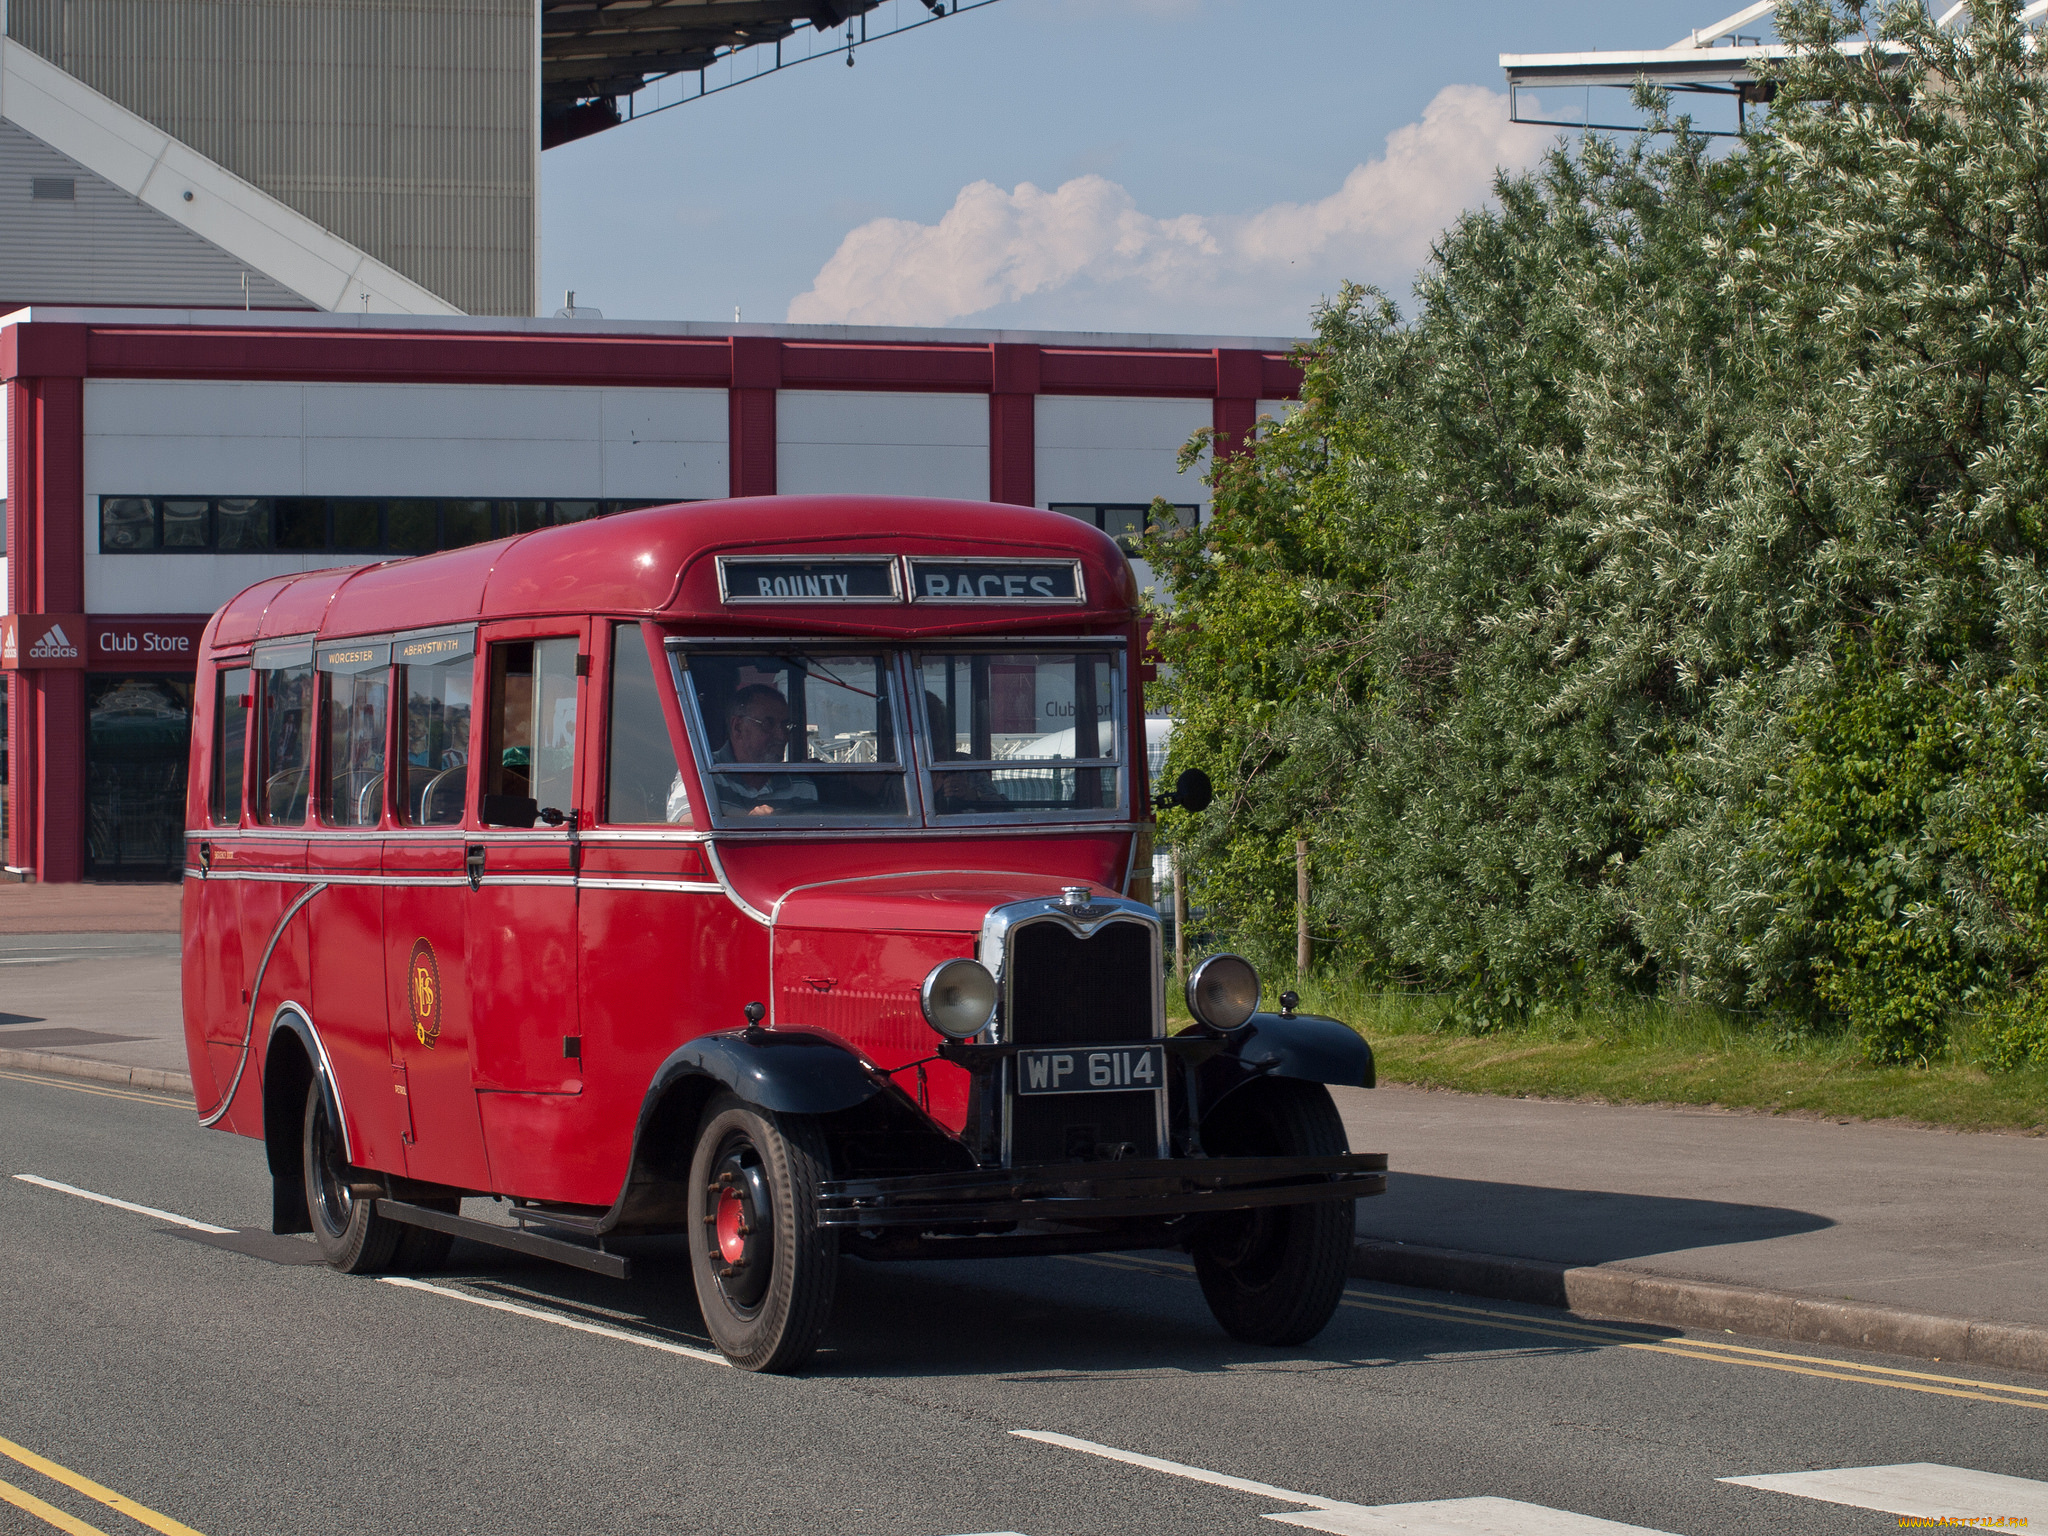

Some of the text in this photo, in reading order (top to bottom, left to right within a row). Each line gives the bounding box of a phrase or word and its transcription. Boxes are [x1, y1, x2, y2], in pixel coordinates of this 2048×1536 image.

[758, 574, 848, 596] BOUNTY
[925, 574, 1054, 597] RACES
[100, 632, 189, 651] Club Store
[403, 639, 459, 656] ABERYSTWYTH
[29, 645, 78, 658] adidas
[329, 650, 373, 664] WORCESTER
[1045, 701, 1077, 717] Club
[1027, 1052, 1155, 1089] WP 6114
